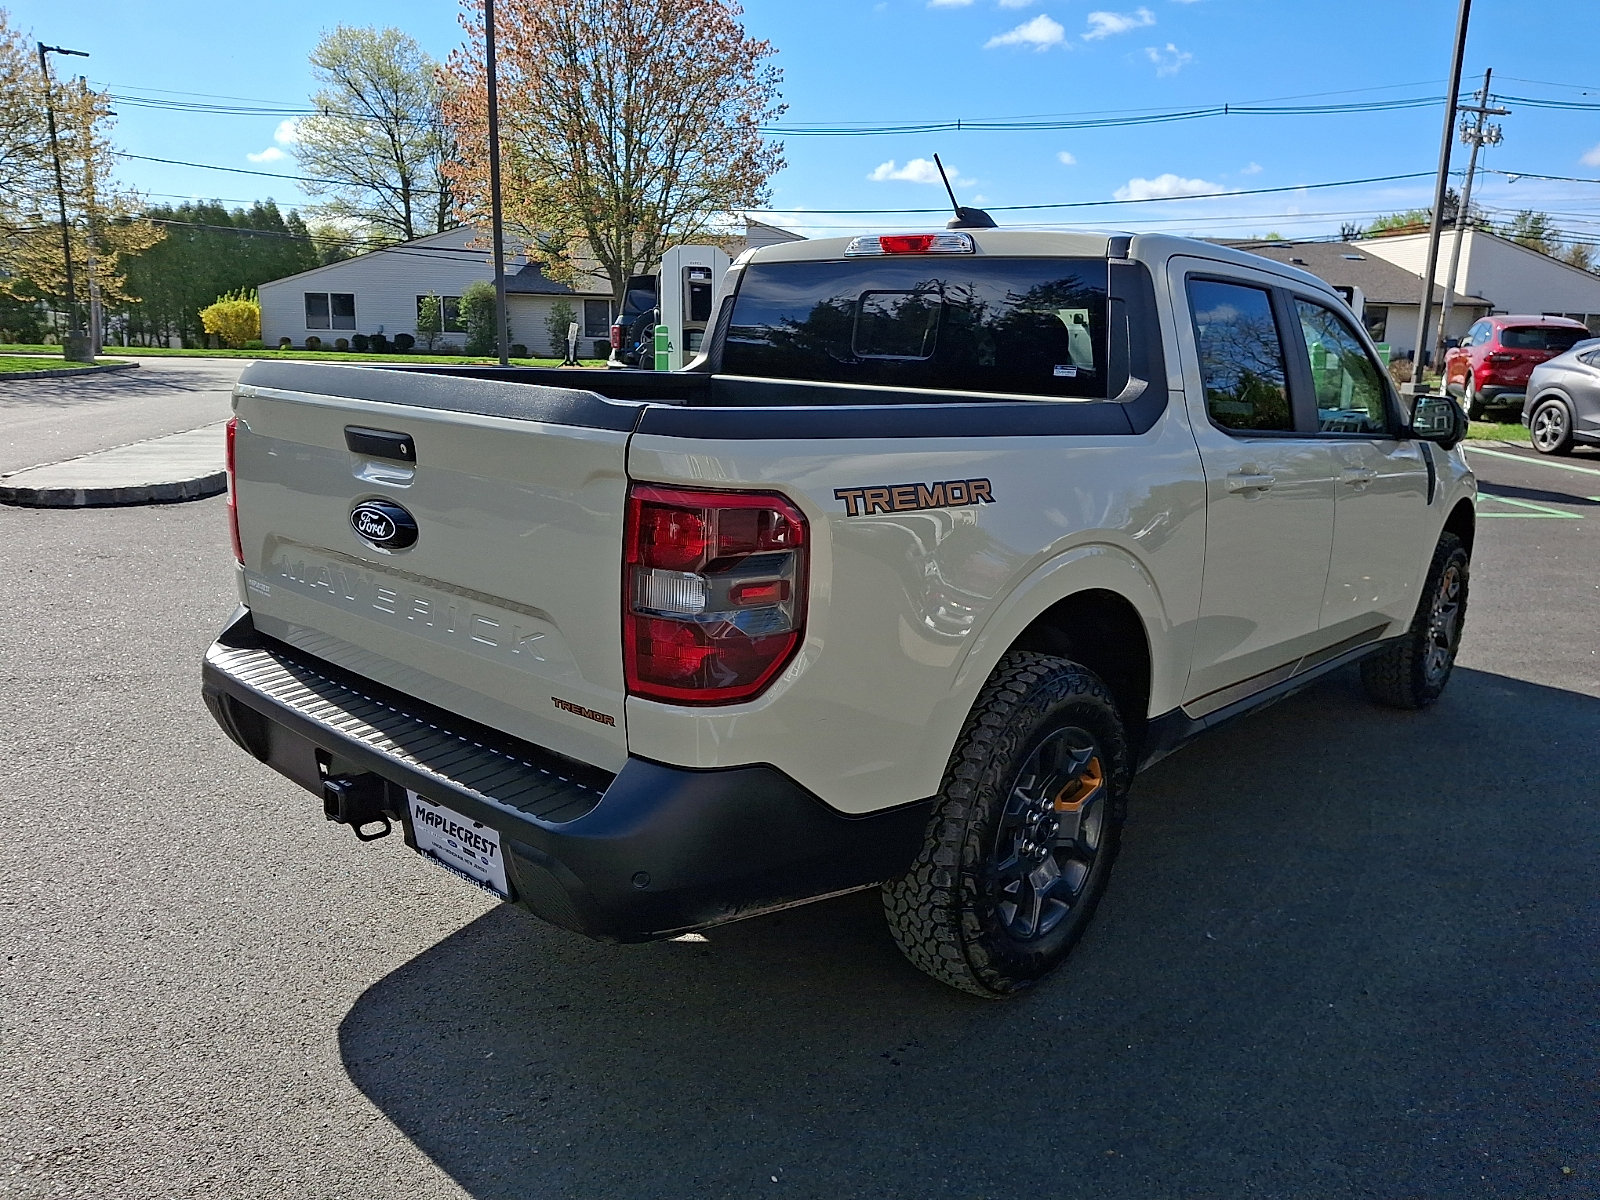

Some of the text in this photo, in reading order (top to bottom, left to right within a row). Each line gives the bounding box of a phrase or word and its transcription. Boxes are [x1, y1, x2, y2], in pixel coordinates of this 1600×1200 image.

[834, 478, 996, 517] TREMOR
[359, 511, 387, 537] Ford
[281, 554, 545, 662] MAVERICK
[551, 697, 616, 727] TREMOR
[416, 805, 498, 857] MAPLECREST
